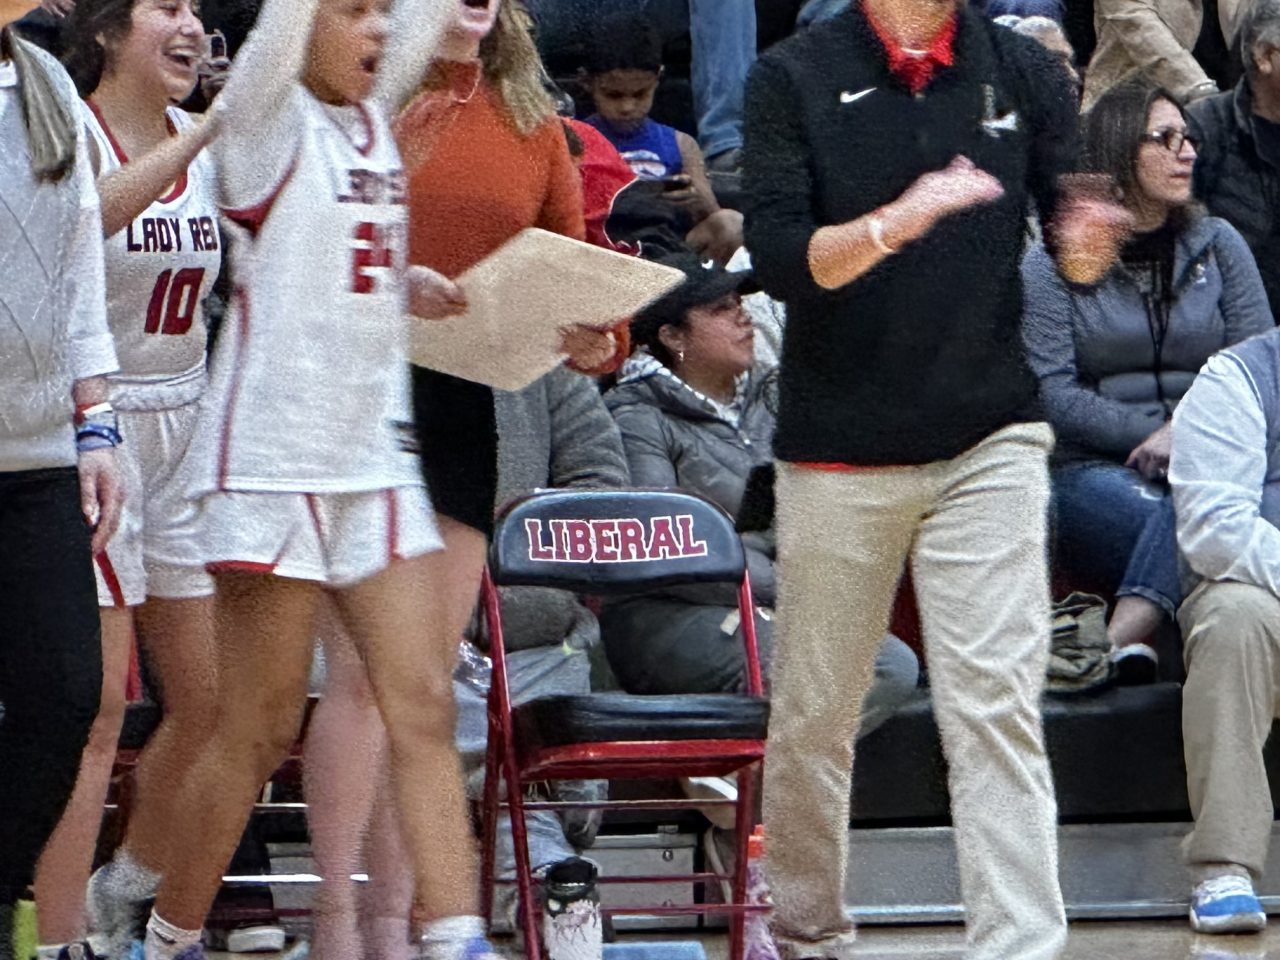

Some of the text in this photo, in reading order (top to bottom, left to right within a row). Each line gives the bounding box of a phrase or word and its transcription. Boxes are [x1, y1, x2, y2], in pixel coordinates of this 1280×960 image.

[127, 217, 182, 252] LADY
[144, 267, 205, 335] 10
[524, 514, 708, 564] LIBERAL
